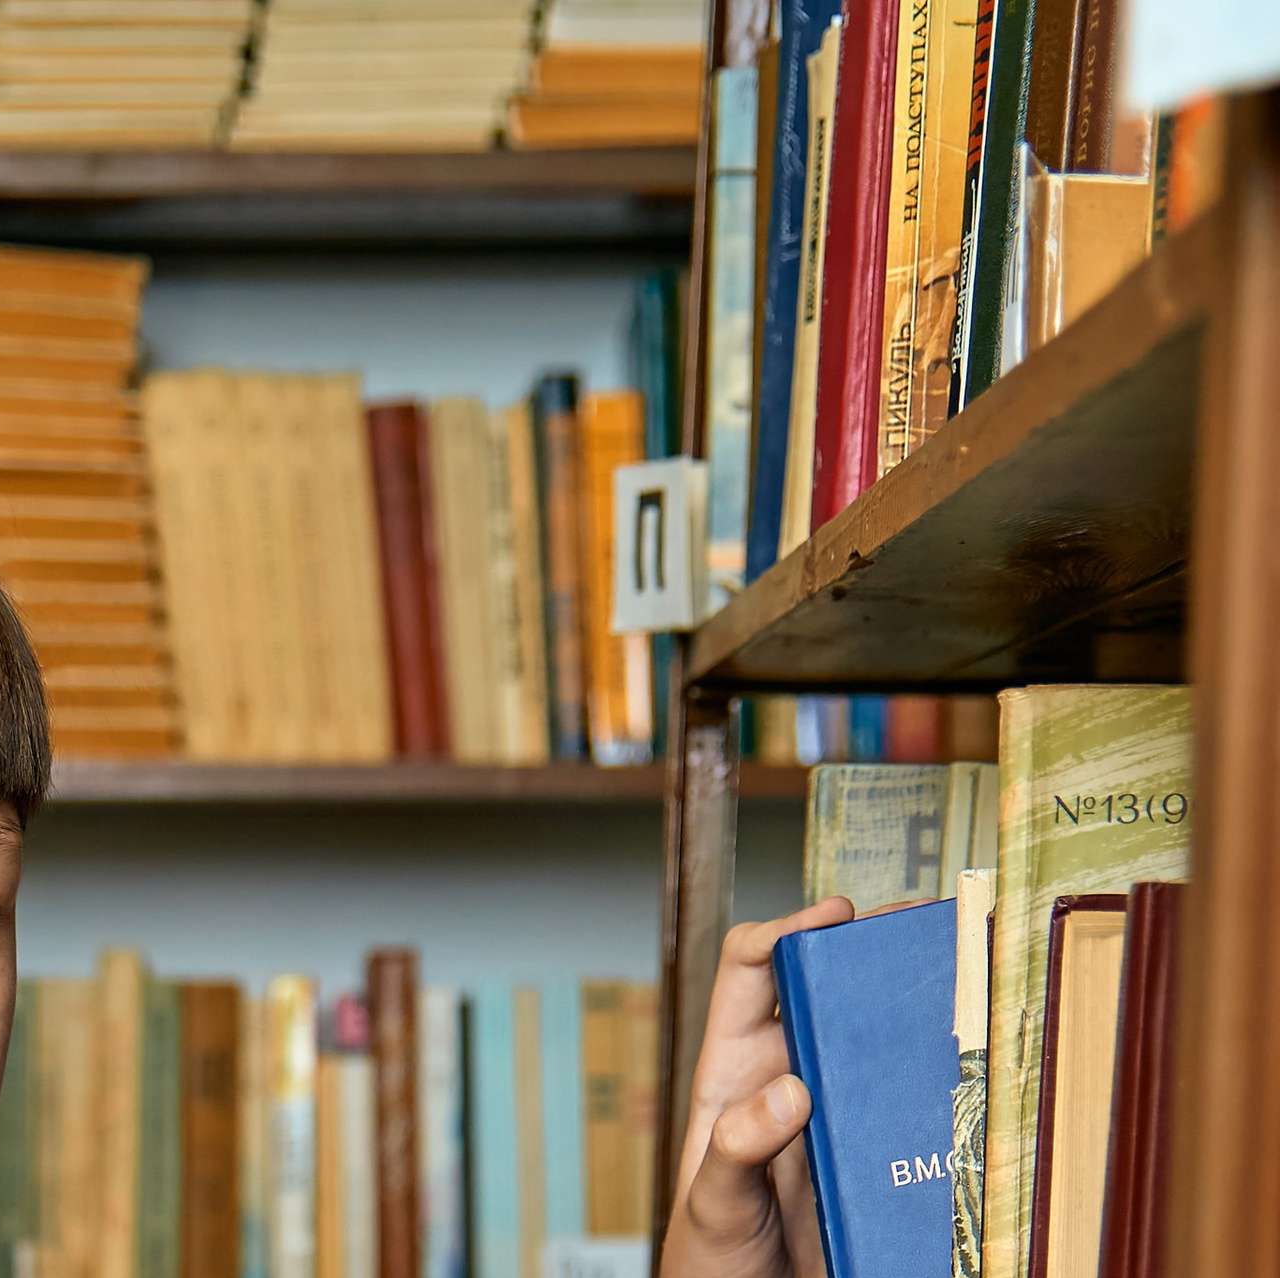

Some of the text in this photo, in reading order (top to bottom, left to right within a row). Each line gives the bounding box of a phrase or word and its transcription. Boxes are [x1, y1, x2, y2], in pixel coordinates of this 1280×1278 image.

[903, 2, 928, 224] НА ПОДСТУПАХ
[635, 487, 665, 594] П
